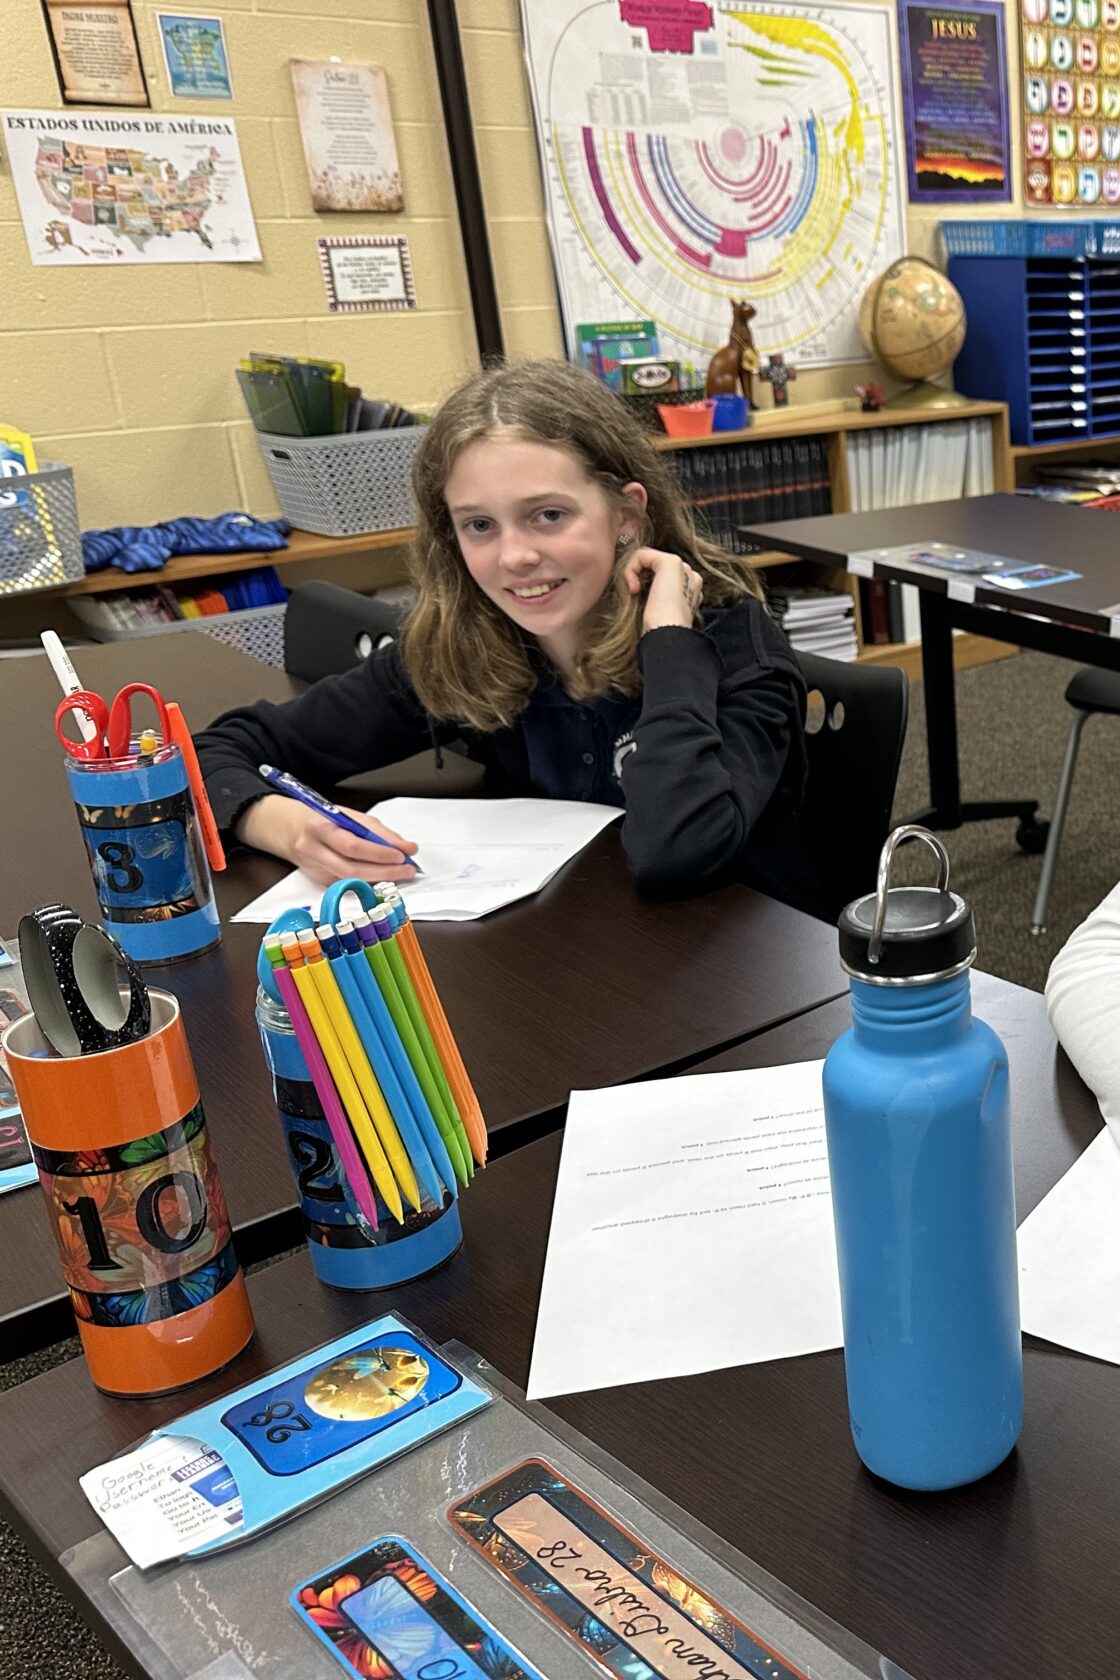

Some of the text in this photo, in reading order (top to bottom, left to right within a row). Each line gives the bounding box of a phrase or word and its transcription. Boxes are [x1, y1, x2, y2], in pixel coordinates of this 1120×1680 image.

[931, 17, 977, 40] JESUS
[7, 116, 233, 136] ESTADOS UNIDOS DE AMÉRICA
[98, 842, 145, 894] 3
[288, 1130, 346, 1203] 2
[64, 1170, 208, 1271] 10
[242, 1400, 314, 1444] 28
[95, 1465, 174, 1505] Username
[101, 1462, 156, 1490] Google
[536, 1540, 583, 1568] 28
